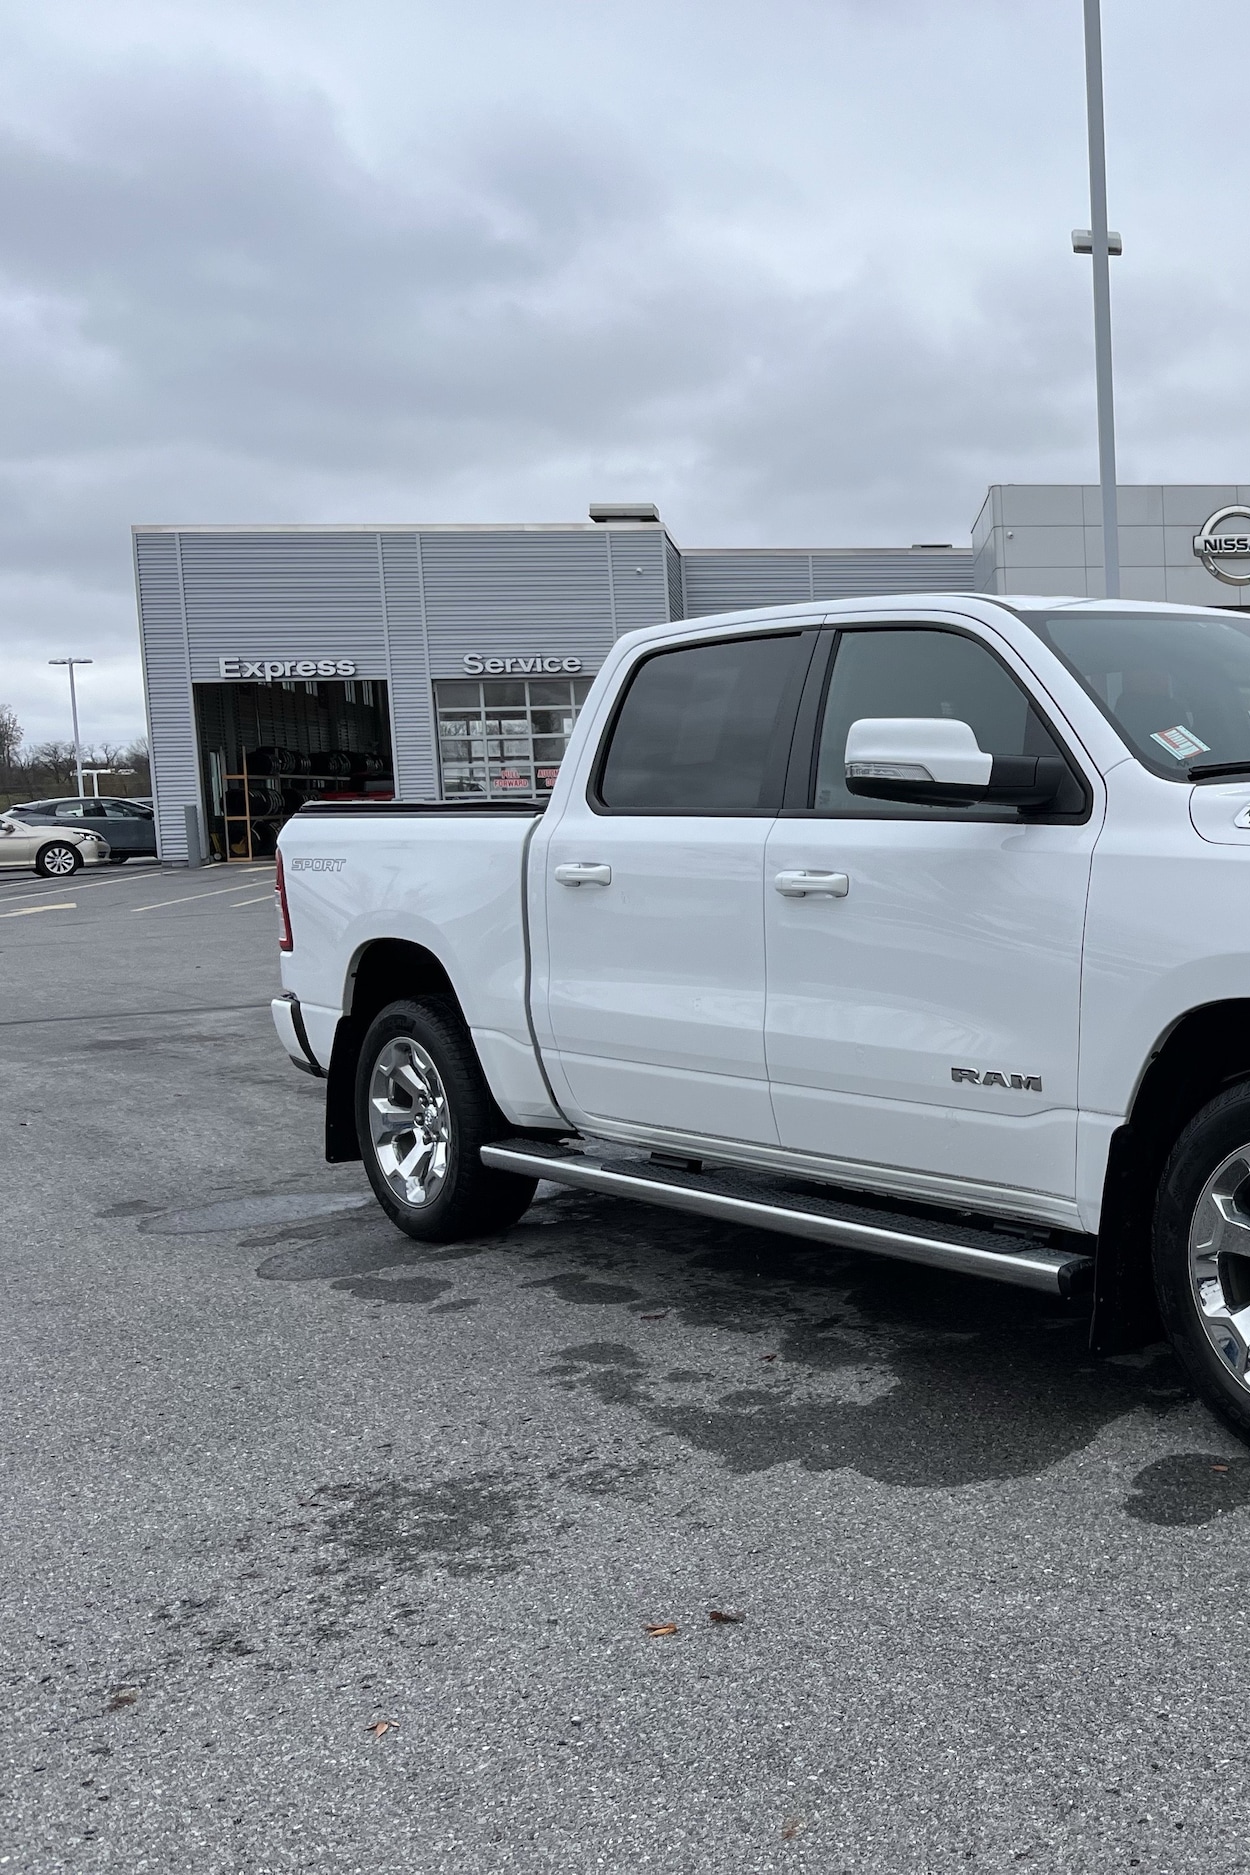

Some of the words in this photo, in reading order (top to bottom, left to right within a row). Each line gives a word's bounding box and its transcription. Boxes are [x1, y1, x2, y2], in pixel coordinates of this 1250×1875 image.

[218, 656, 356, 682] Express
[462, 653, 582, 675] Service
[501, 769, 519, 778] PULL
[494, 779, 529, 788] FORWARD
[291, 858, 347, 872] SPORT
[951, 1067, 1042, 1092] RAM
